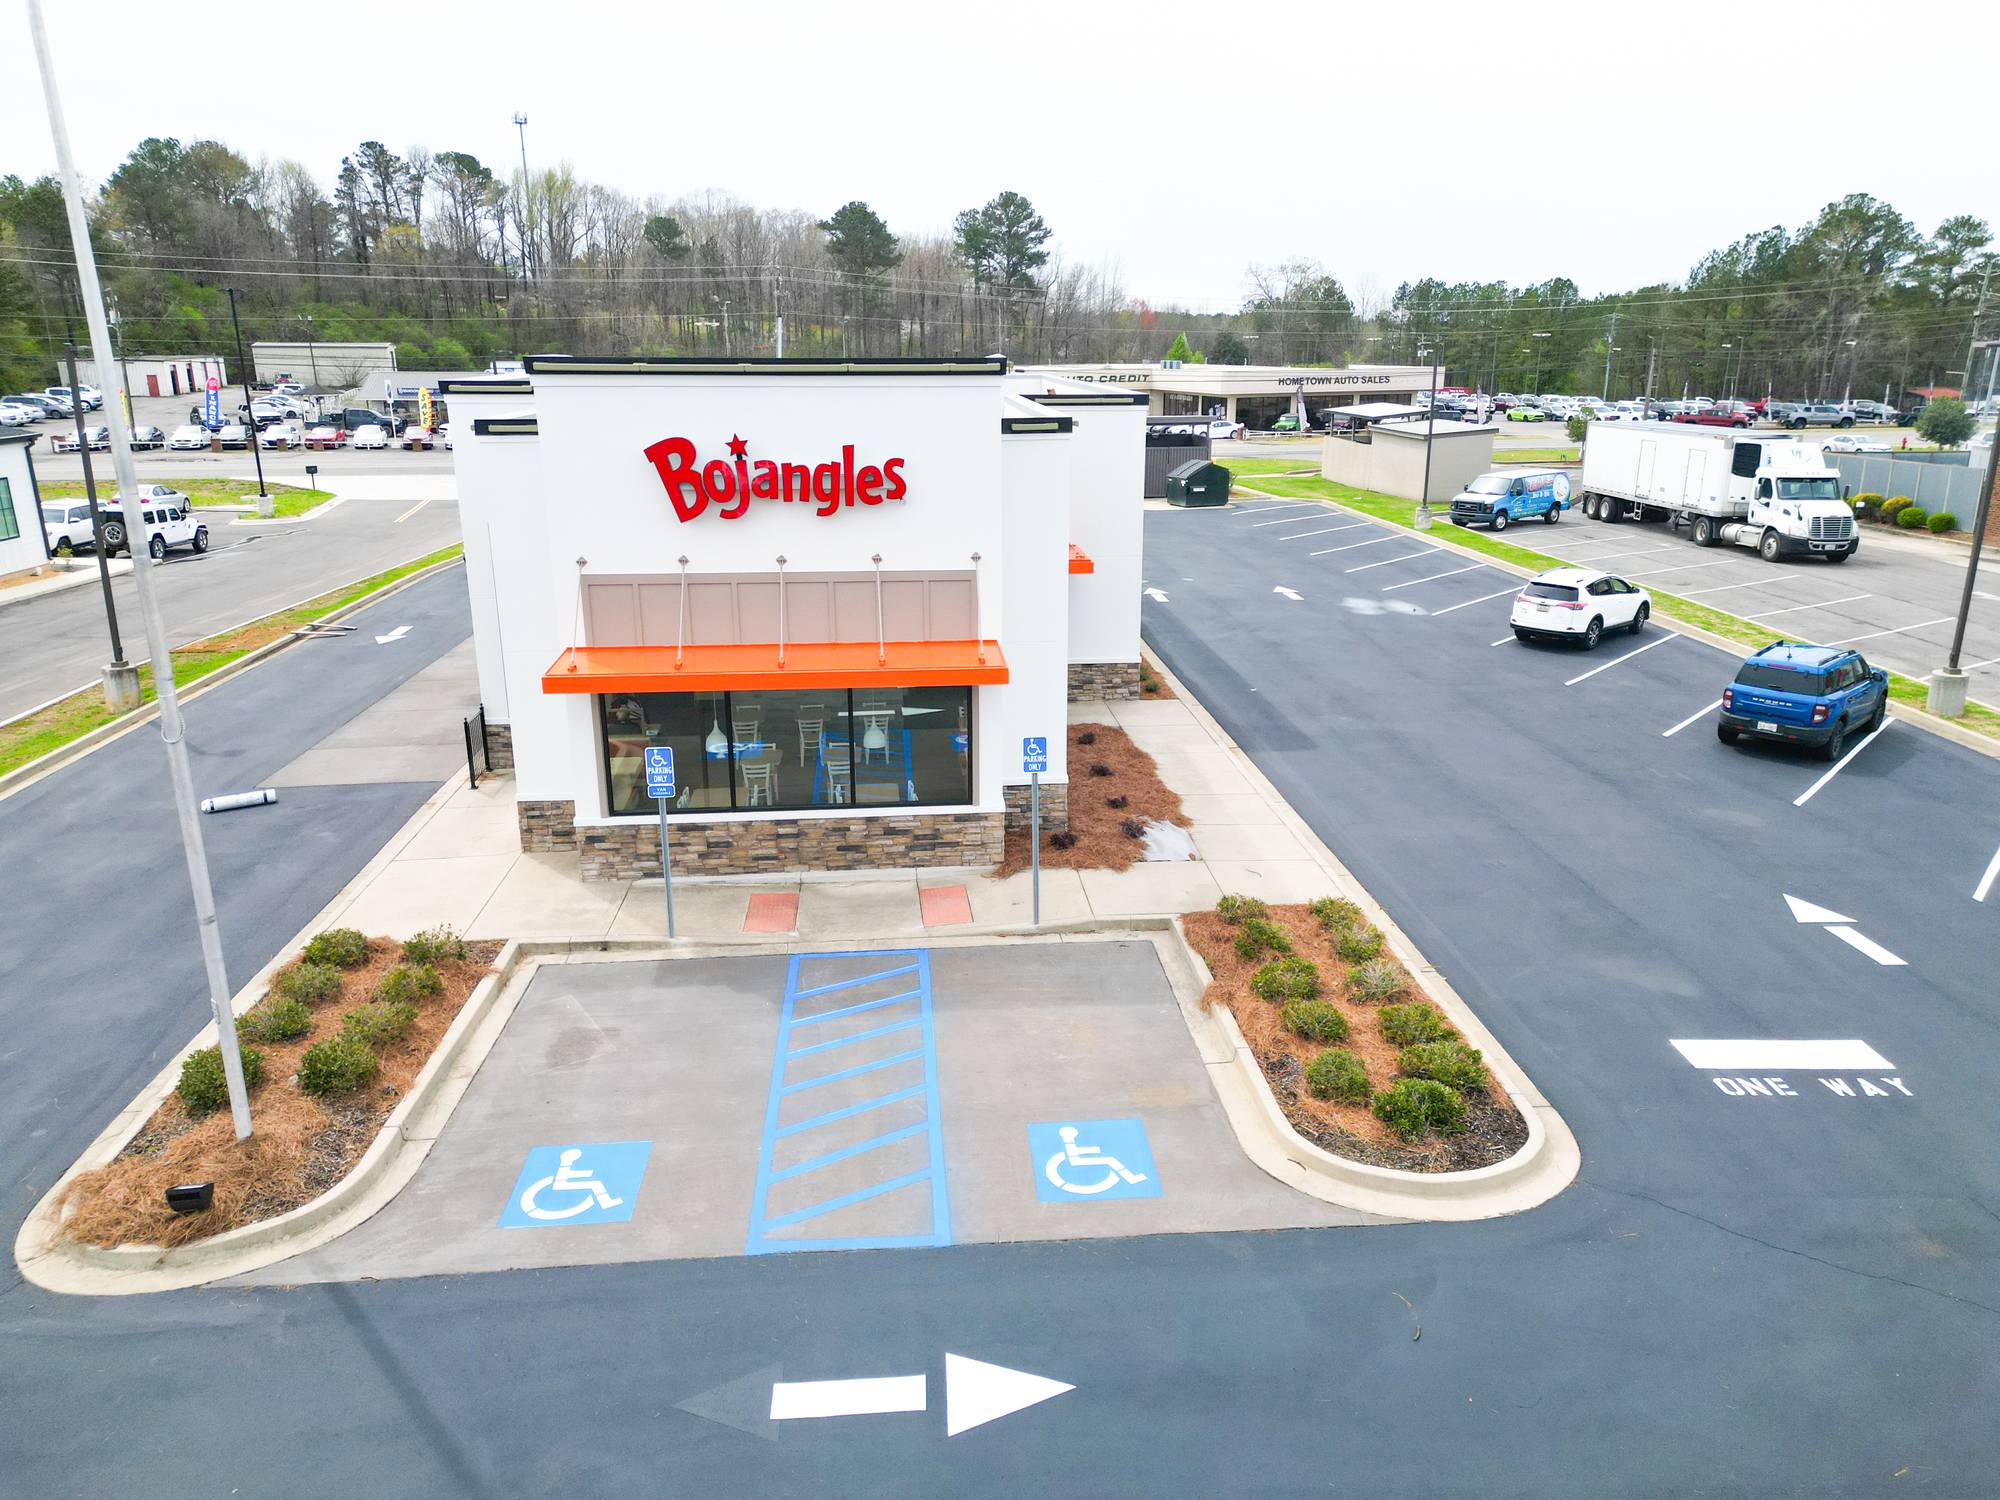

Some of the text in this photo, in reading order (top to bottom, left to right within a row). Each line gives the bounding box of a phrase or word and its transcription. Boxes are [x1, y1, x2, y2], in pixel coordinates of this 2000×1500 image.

[1099, 374, 1151, 383] CREDIT
[1278, 375, 1390, 386] HOMETOWN AUTO SALES
[421, 394, 429, 425] SAVE
[643, 433, 907, 523] Bojangles
[648, 767, 672, 775] PARKING
[653, 775, 668, 783] ONLY
[1712, 1077, 1914, 1097] ONE WAY
